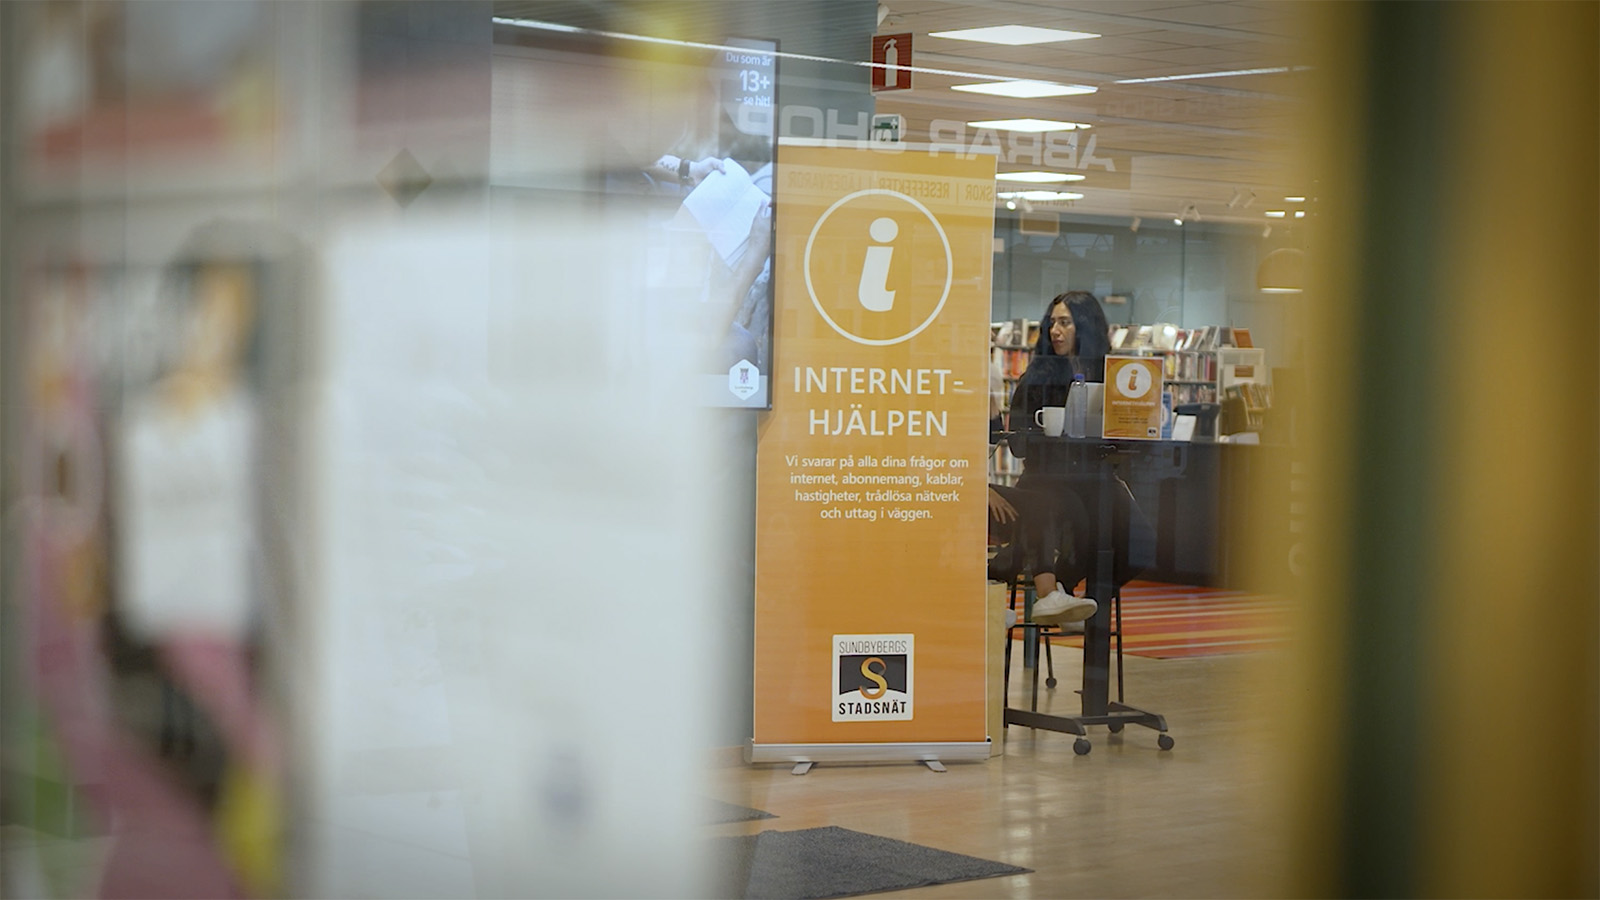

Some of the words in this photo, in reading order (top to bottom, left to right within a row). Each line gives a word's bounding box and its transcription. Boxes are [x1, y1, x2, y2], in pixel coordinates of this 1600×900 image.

[726, 52, 739, 63] Du
[741, 54, 760, 65] som
[762, 55, 772, 66] är
[740, 69, 770, 92] 13+
[744, 96, 754, 106] se
[793, 366, 964, 395] INTERNET-
[808, 403, 948, 437] HJÄLPEN
[785, 455, 799, 467] Vi
[801, 457, 836, 468] svarar
[839, 454, 855, 470] på
[857, 455, 878, 468] alla
[881, 455, 907, 468] dina
[909, 454, 946, 471] frågor
[949, 458, 969, 469] om
[790, 471, 838, 486] internet,
[841, 471, 923, 487] abonnemang,
[925, 470, 965, 487] kablar,
[794, 489, 862, 505] hastigheter,
[865, 489, 912, 502] trådlösa
[915, 490, 960, 502] nätverk
[820, 506, 842, 519] och
[844, 507, 877, 522] uttag
[880, 506, 885, 519] i
[887, 507, 934, 522] väggen.
[838, 640, 907, 654] SUNDBYBERGS
[838, 699, 907, 715] STADSNÄT
